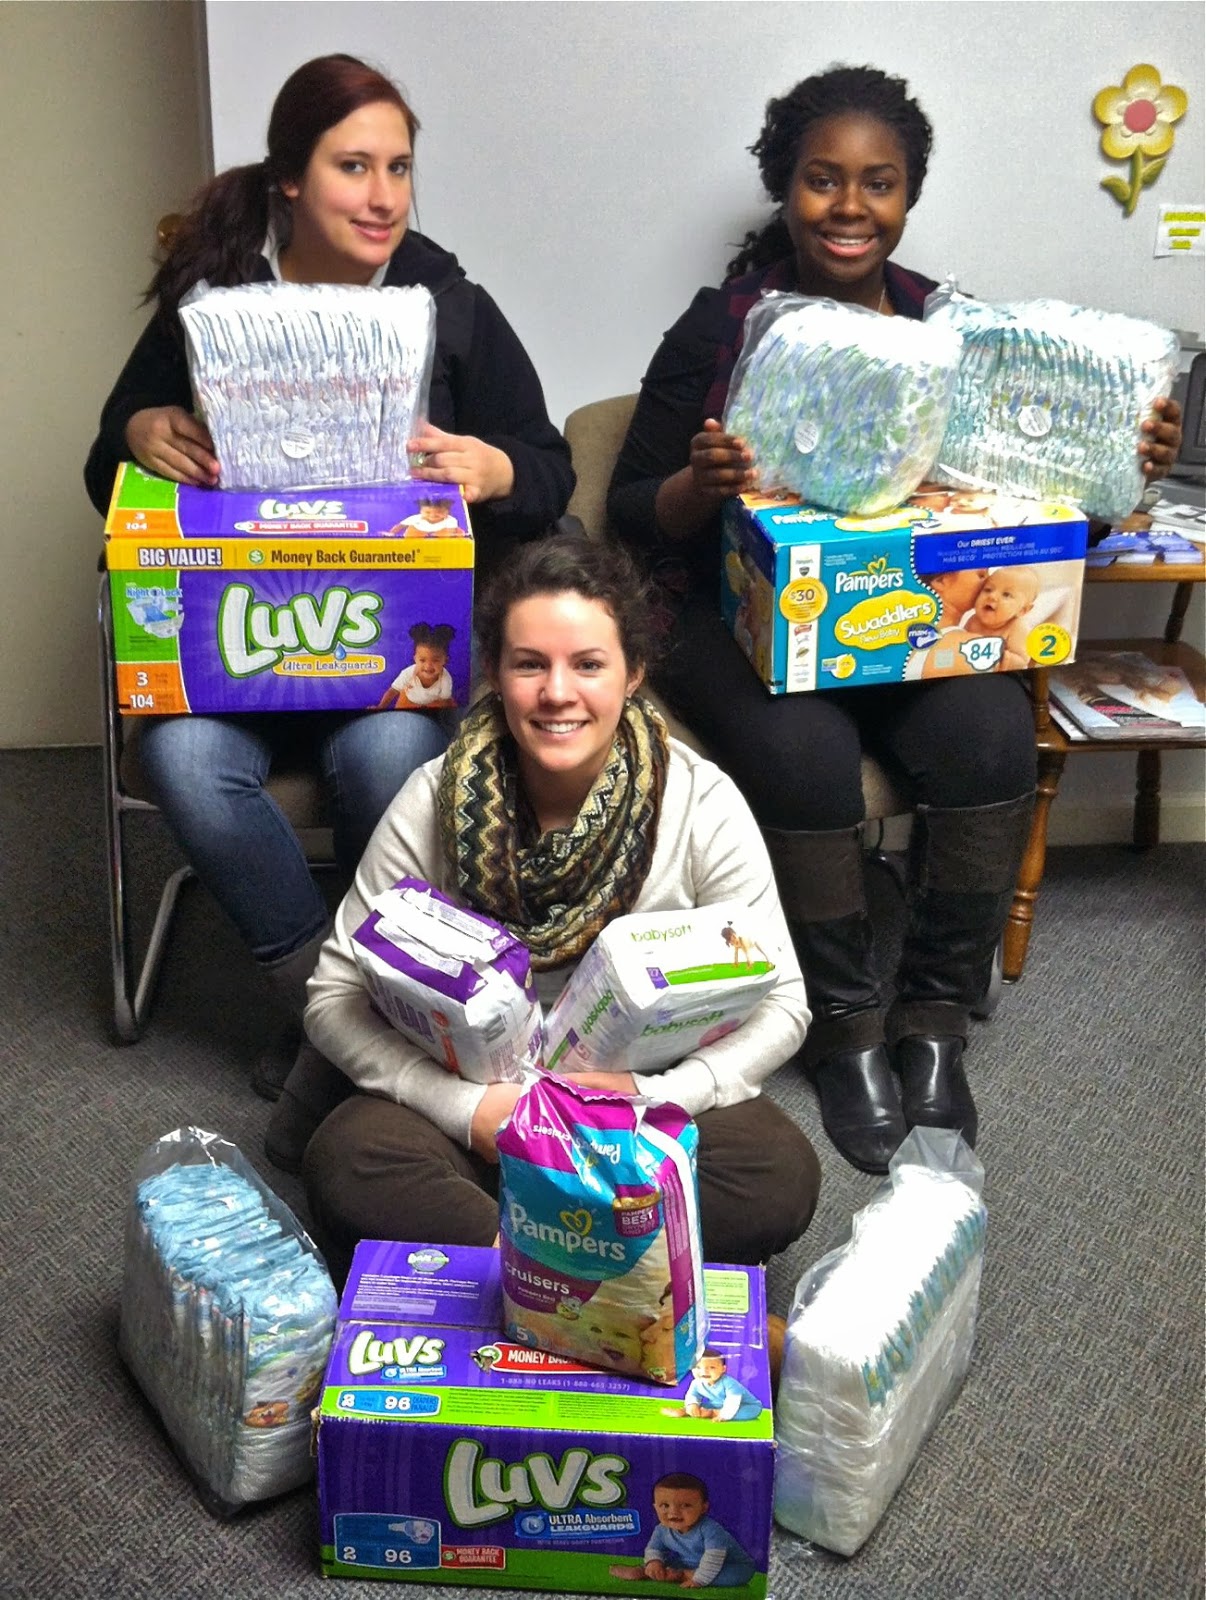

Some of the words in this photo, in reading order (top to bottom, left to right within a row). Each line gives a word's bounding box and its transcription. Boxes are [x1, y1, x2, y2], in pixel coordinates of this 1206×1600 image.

[138, 548, 166, 567] BIG
[168, 547, 223, 567] VALUE!
[271, 550, 313, 566] Money
[316, 549, 346, 563] Back
[835, 571, 904, 595] Pampers
[789, 588, 816, 602] $30
[840, 602, 932, 639] Swaddlers
[970, 642, 993, 661] 84
[1039, 635, 1057, 657] 2
[282, 660, 313, 672] Ultra
[316, 660, 379, 673] Leakguards
[136, 671, 149, 687] 3
[129, 693, 154, 709] 104
[630, 924, 693, 942] babysoft
[621, 1209, 654, 1225] BEST
[509, 1200, 627, 1262] Pampers
[516, 1326, 529, 1341] 5
[507, 1349, 545, 1364] MONEY
[384, 1395, 411, 1411] 96
[549, 1514, 583, 1525] ULTRA
[585, 1513, 633, 1524] Absorbent
[550, 1522, 635, 1533] LEAKGUARDS
[343, 1546, 357, 1560] 2
[384, 1549, 412, 1564] 96
[458, 1554, 497, 1563] GUARANTEE
[481, 1548, 500, 1556] BACK
